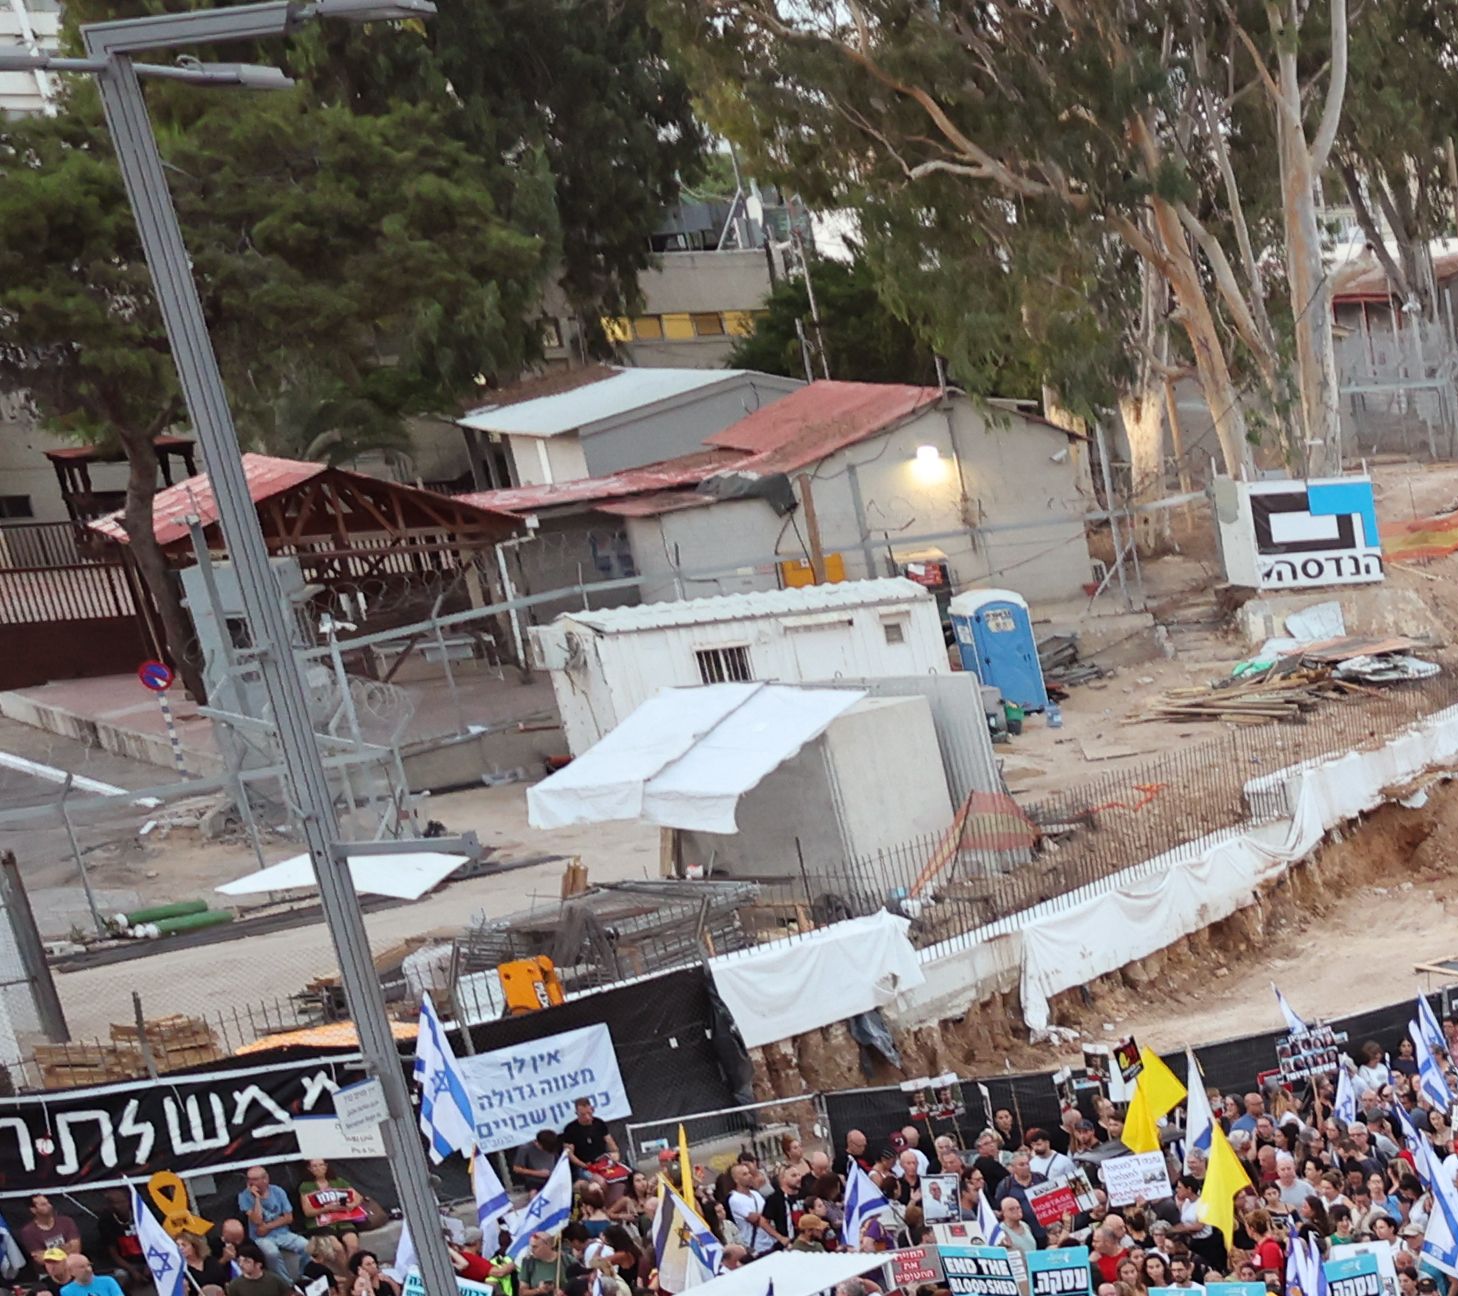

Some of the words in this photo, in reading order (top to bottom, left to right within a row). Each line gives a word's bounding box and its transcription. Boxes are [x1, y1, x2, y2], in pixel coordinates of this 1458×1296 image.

[500, 1052, 524, 1075] לך
[527, 1048, 561, 1071] אין
[539, 1067, 596, 1095] מצווה
[476, 1078, 537, 1112] גדולה
[475, 1108, 544, 1144] שבויים
[946, 1257, 976, 1276] END
[979, 1258, 1010, 1279] THE
